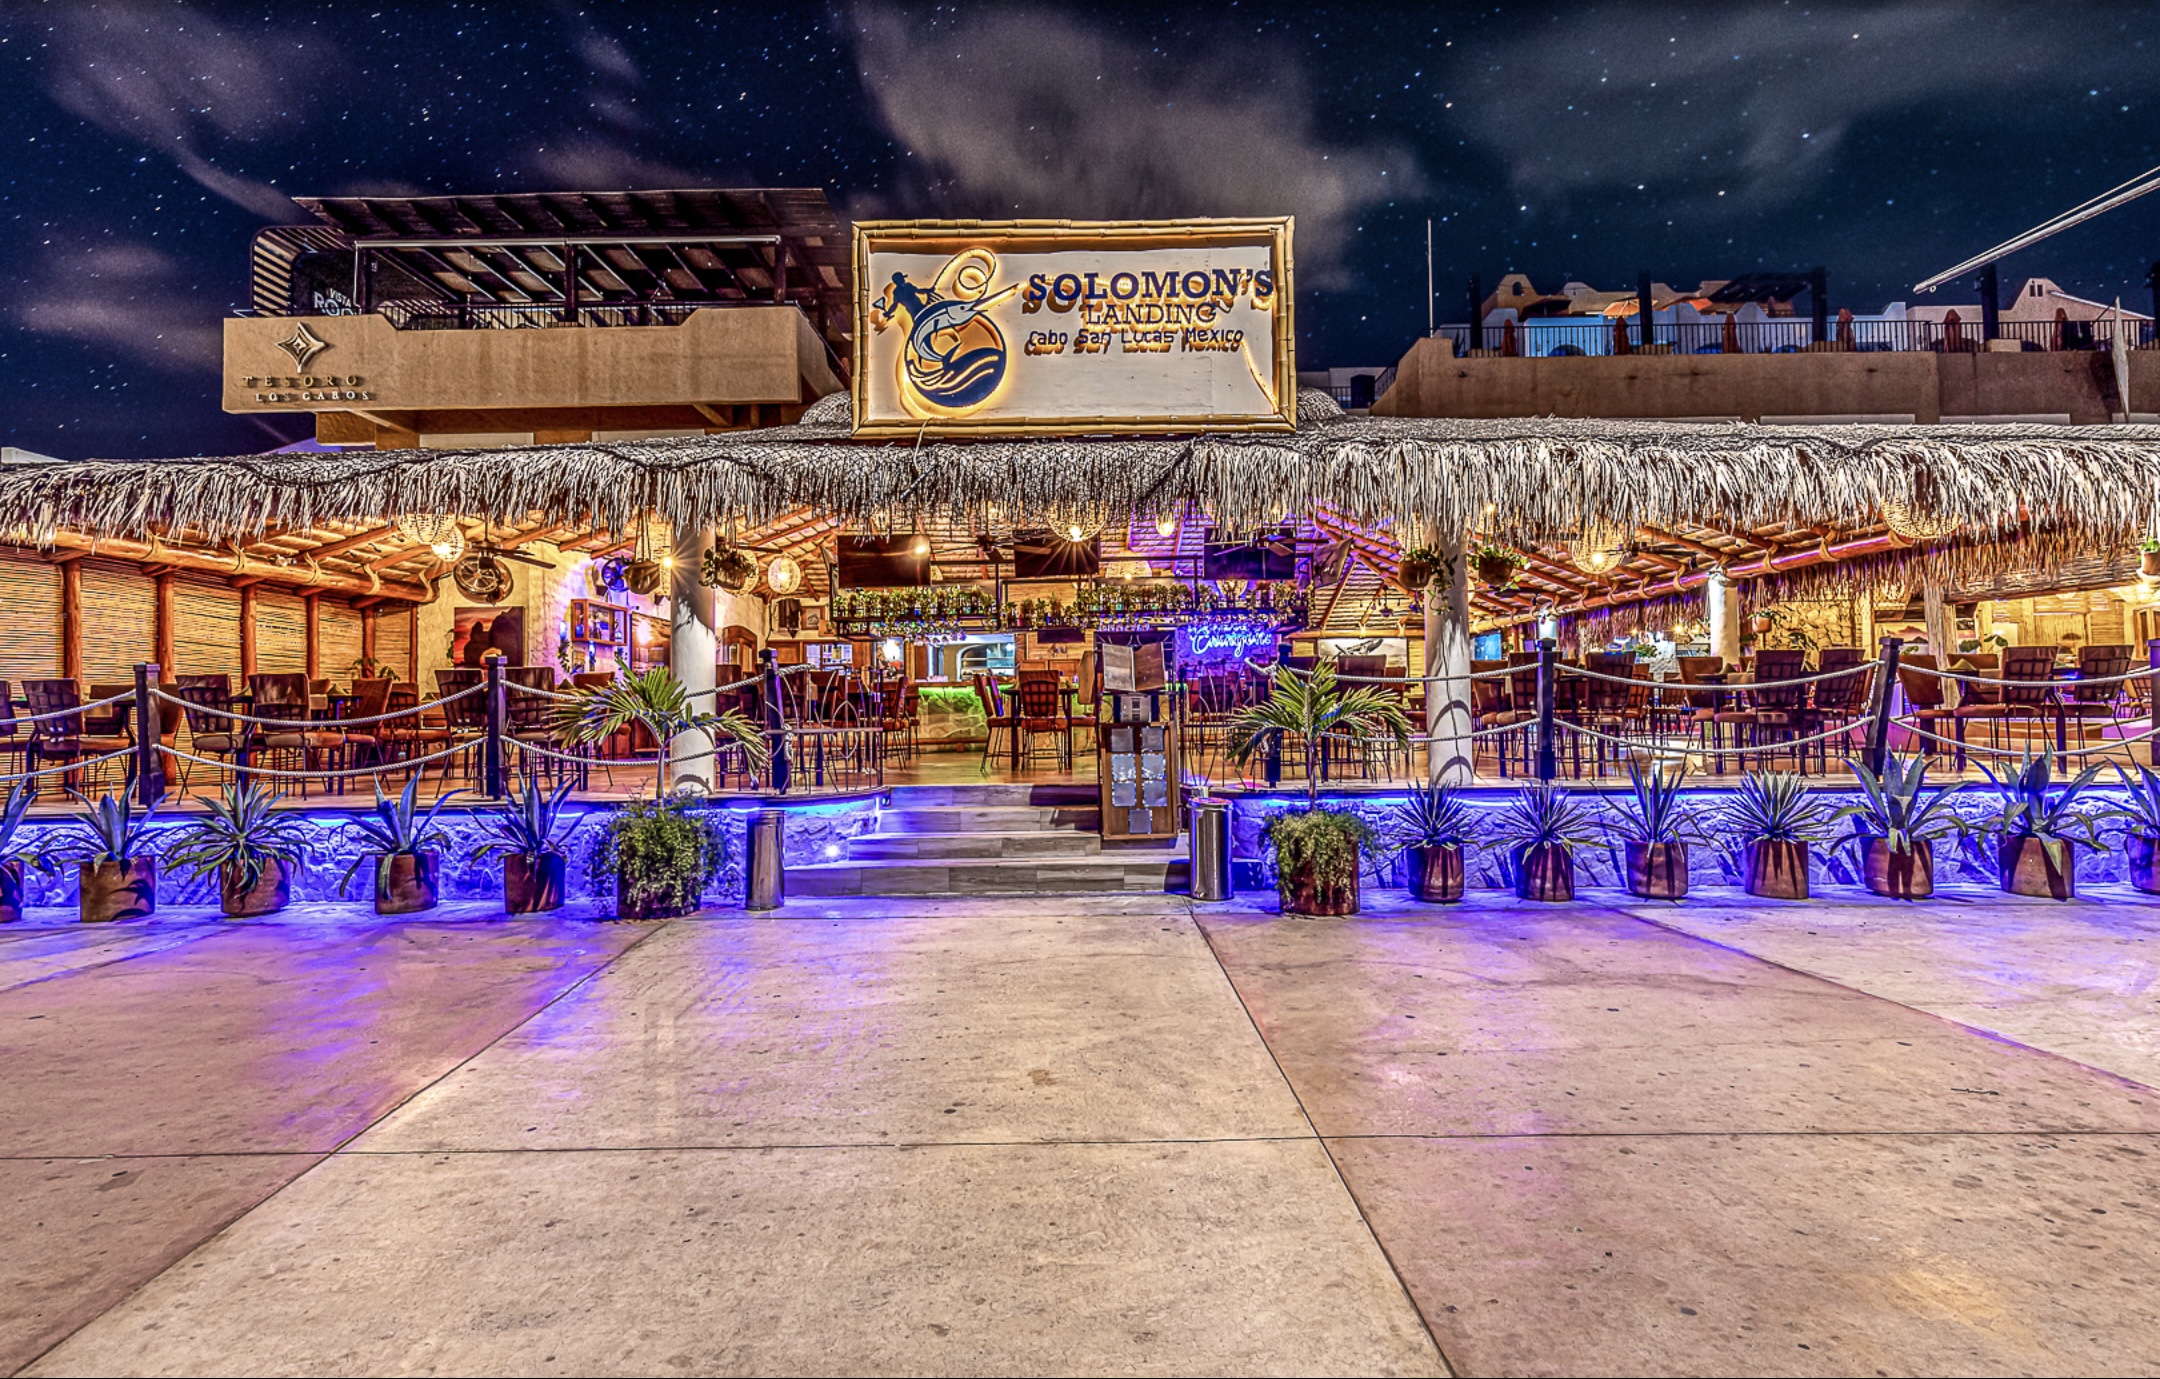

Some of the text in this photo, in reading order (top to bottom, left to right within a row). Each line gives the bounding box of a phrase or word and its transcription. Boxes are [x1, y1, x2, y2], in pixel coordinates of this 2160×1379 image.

[1029, 268, 1274, 300] SOLOMON'S
[329, 288, 352, 308] VISTA
[1086, 302, 1217, 325] LANDING
[1029, 328, 1244, 346] Cabo San Lucas Mexico
[243, 375, 357, 387] TESORO
[255, 390, 369, 402] LOS CABOS
